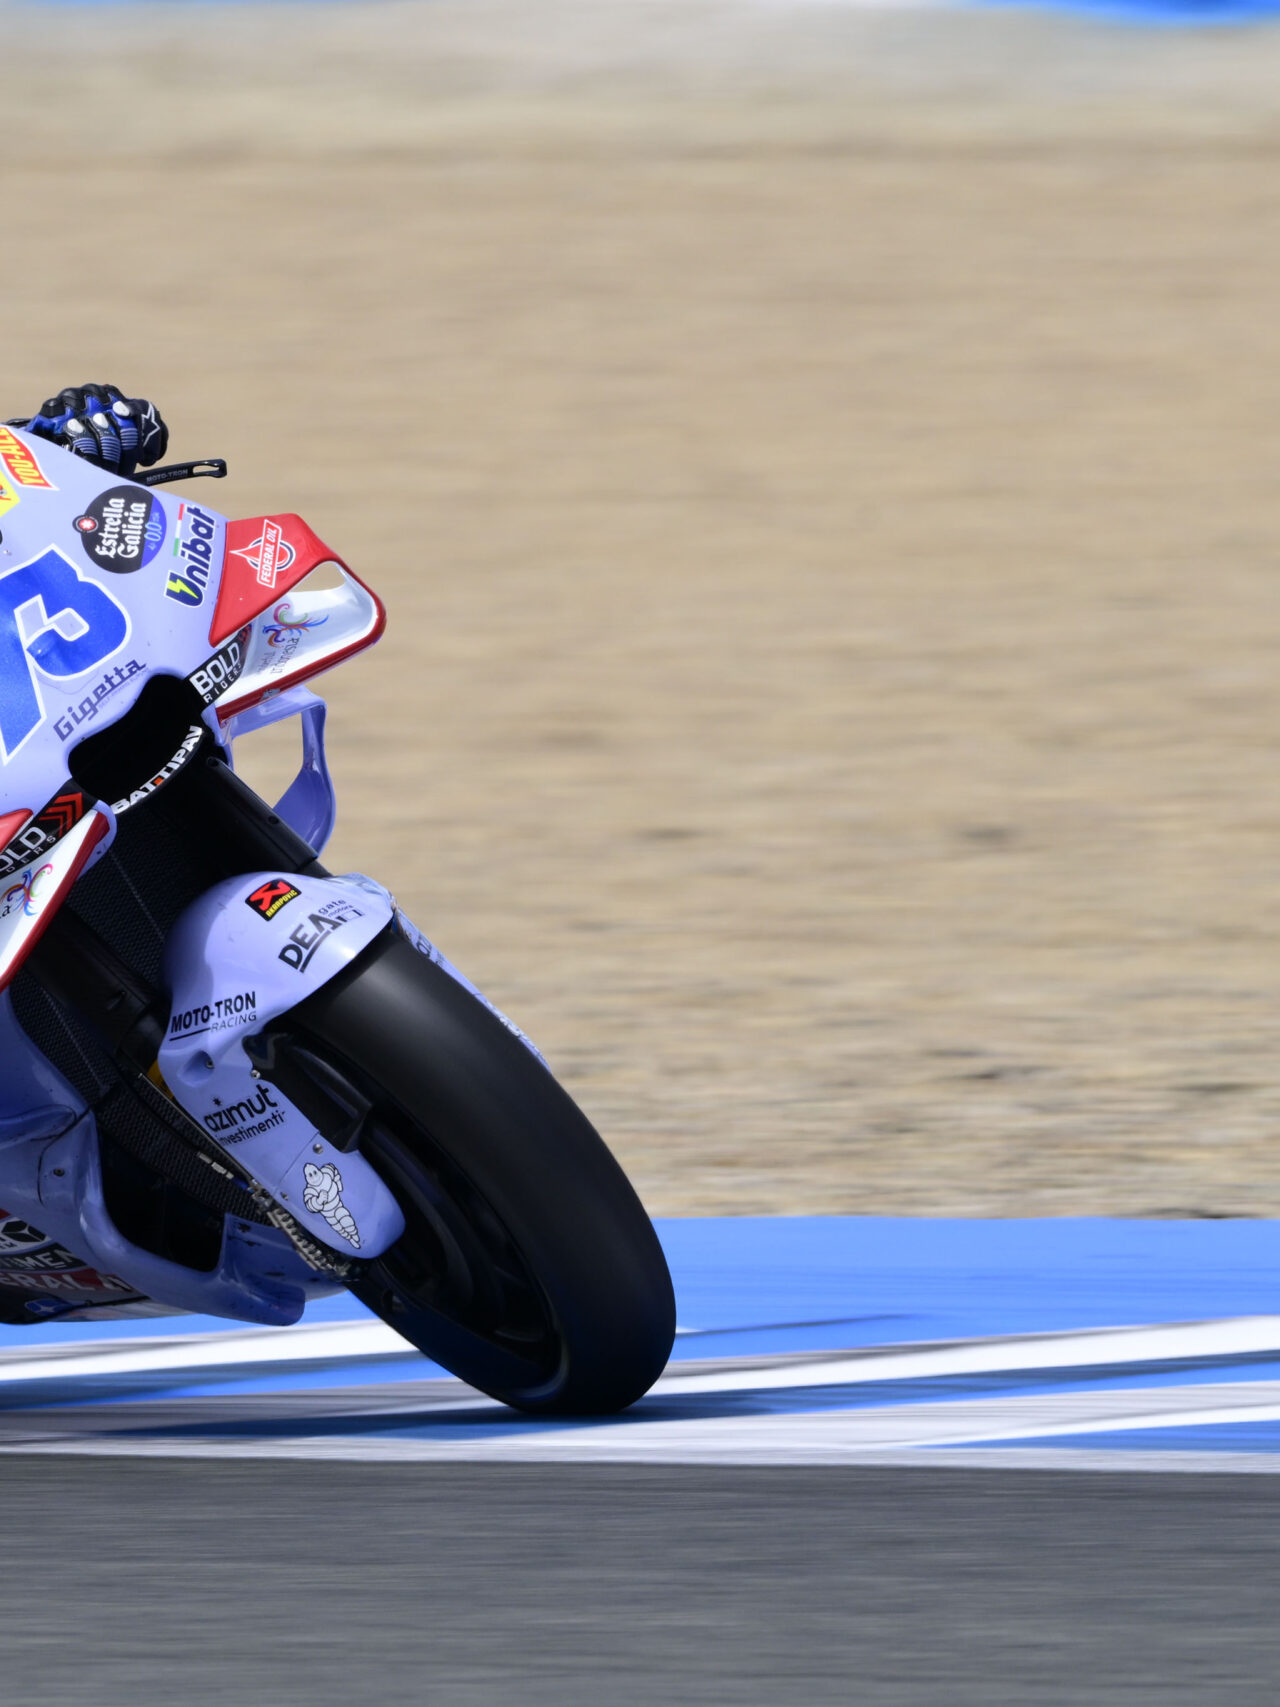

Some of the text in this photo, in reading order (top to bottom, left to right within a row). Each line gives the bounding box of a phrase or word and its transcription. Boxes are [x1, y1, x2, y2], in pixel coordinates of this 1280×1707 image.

[94, 498, 126, 559] Estrella
[117, 502, 147, 559] Galicia
[165, 505, 215, 607] Unibat
[260, 527, 278, 583] FEDERAL OIL
[190, 642, 242, 695] BOLD
[53, 659, 147, 742] Gigetta
[318, 899, 347, 915] gate
[278, 913, 343, 970] DEA
[170, 990, 256, 1034] MOTO-TRON
[210, 1011, 257, 1033] RACING
[203, 1083, 278, 1133] azimut
